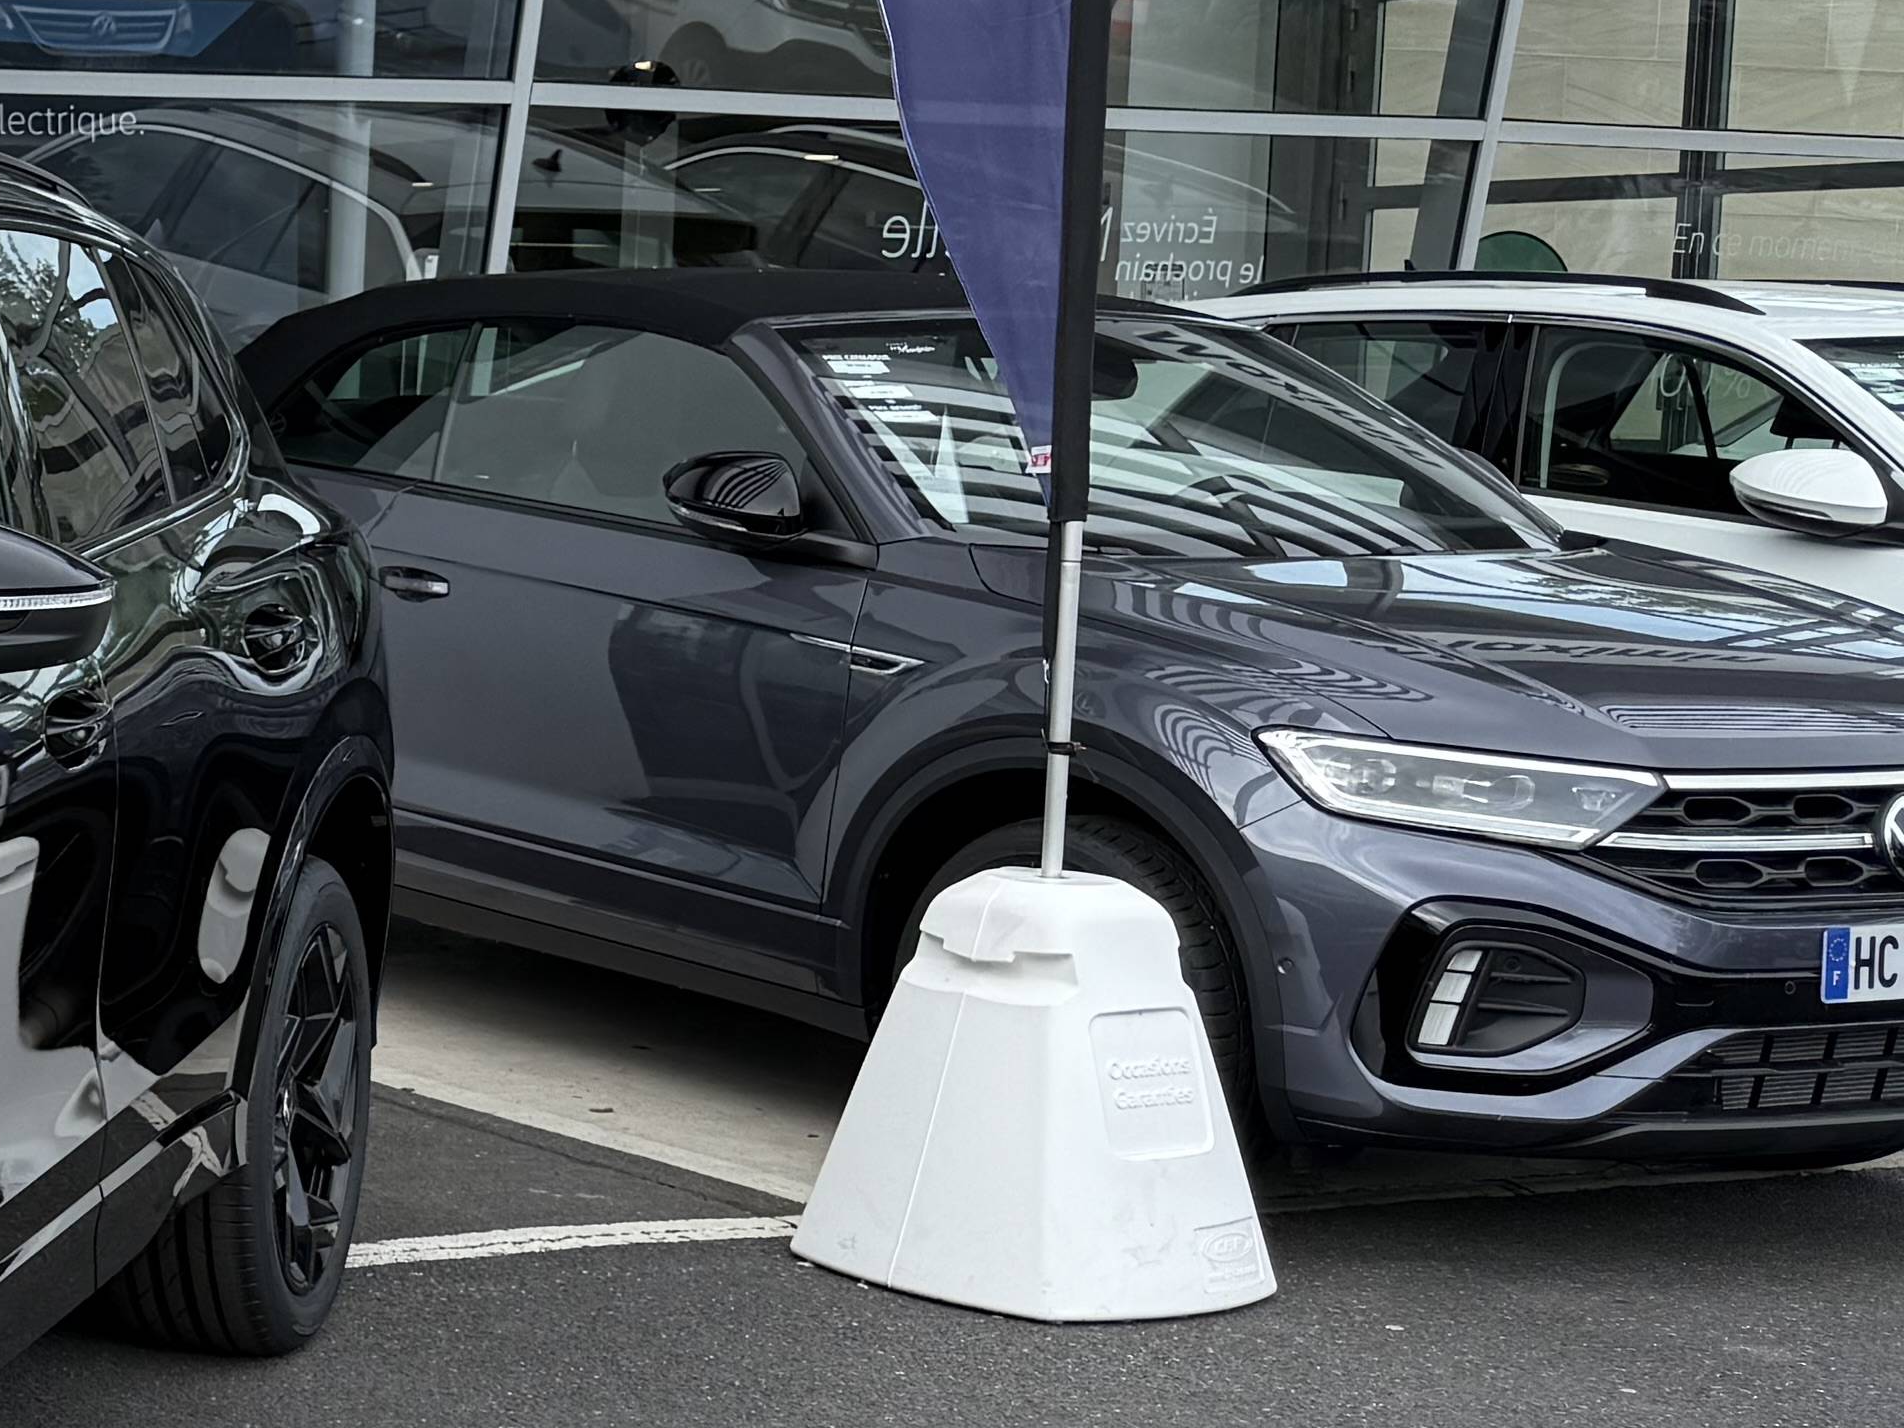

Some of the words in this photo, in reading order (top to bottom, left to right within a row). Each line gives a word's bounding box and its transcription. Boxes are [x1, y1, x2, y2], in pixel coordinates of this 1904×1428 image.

[1672, 222, 1705, 255] En
[1748, 233, 1852, 262] momen
[1853, 935, 1899, 990] HC
[1108, 1055, 1192, 1083] Occasions
[1113, 1081, 1194, 1112] Garanties
